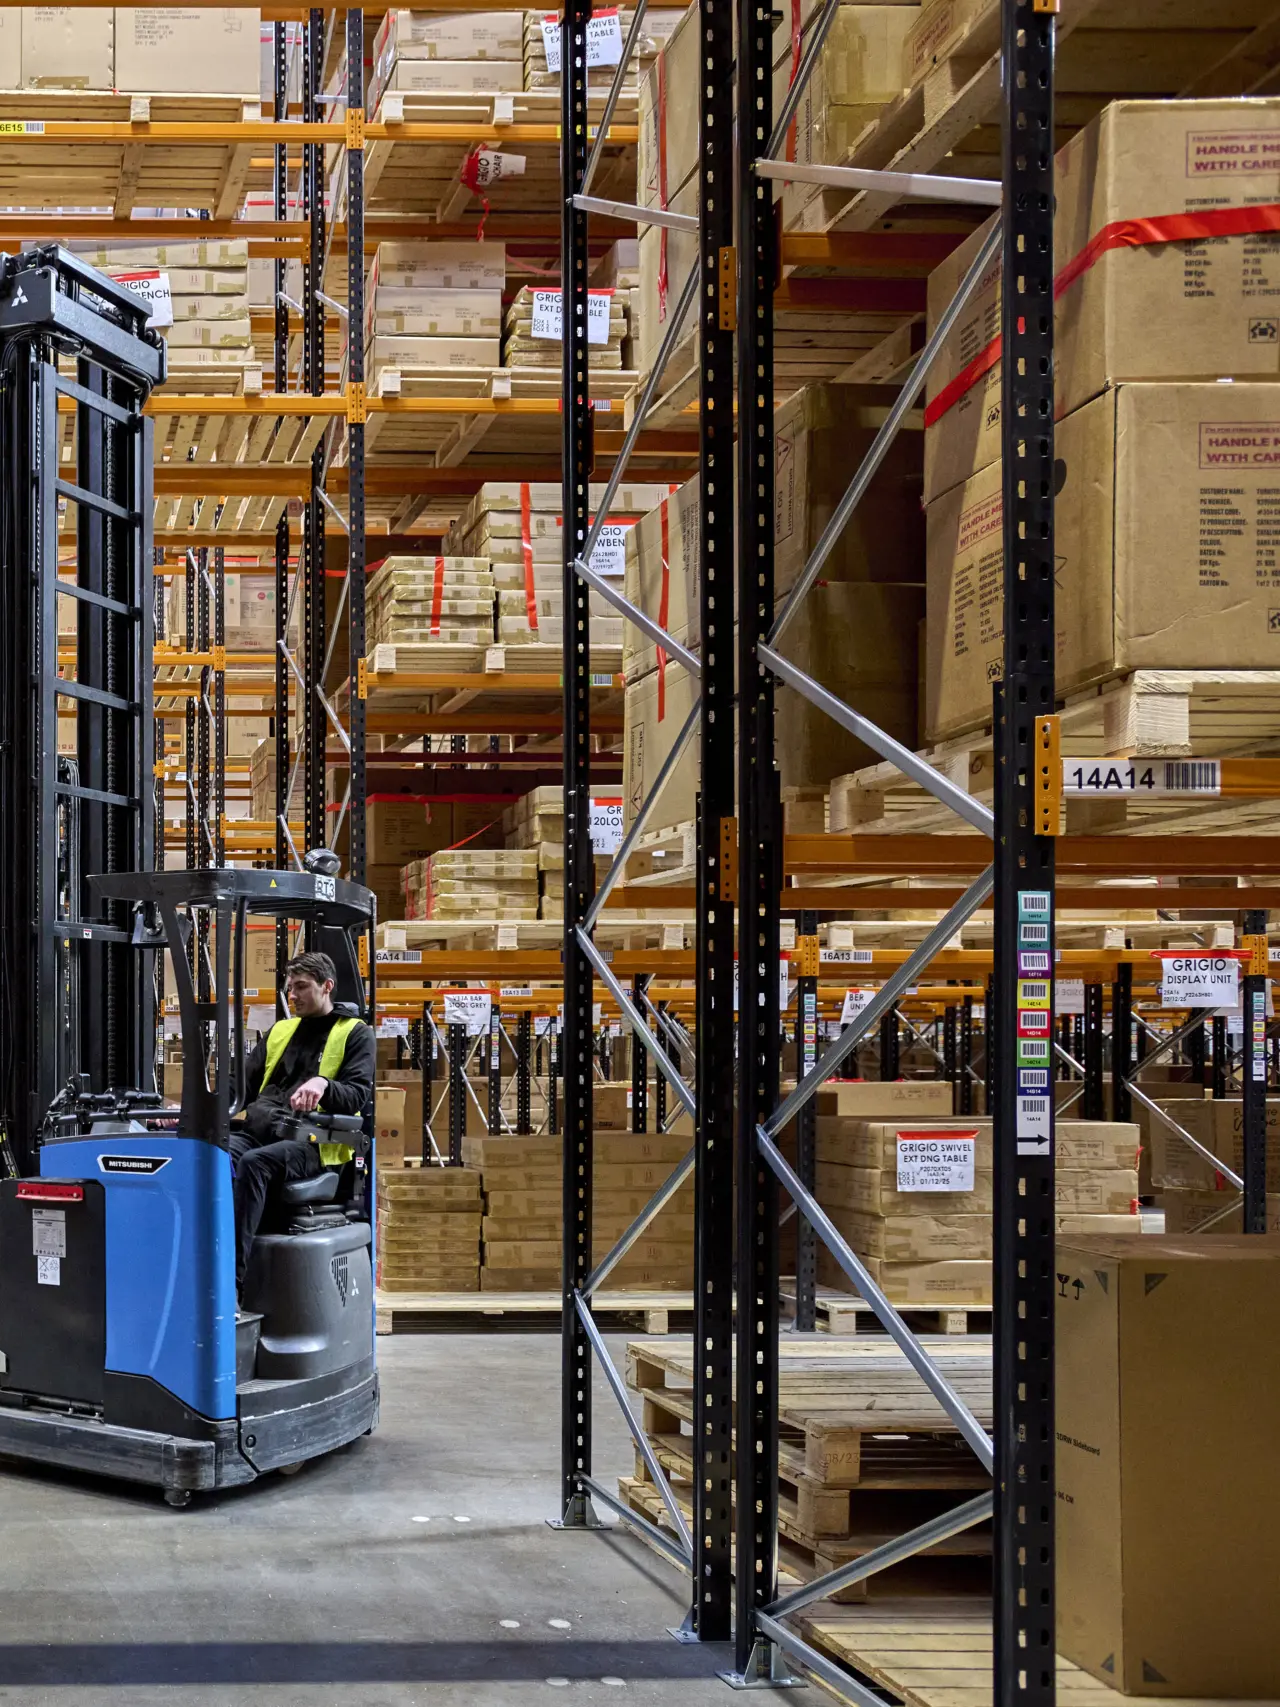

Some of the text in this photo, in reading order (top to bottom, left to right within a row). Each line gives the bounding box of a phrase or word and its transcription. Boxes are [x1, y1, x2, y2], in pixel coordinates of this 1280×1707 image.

[550, 29, 614, 44] EX TABLE
[1196, 144, 1258, 155] HANDLE
[1194, 160, 1237, 171] WITH
[121, 281, 150, 290] IGIO
[536, 292, 608, 308] GRIG IVEL
[540, 304, 554, 312] EXT
[1209, 438, 1270, 447] HANDLE
[1207, 453, 1248, 463] WITH
[960, 510, 991, 534] HANDLE
[600, 527, 622, 536] GIO
[596, 538, 624, 547] WBEN
[960, 530, 979, 548] WITH
[1072, 768, 1155, 790] 14A14
[376, 952, 400, 961] 6A14
[824, 952, 850, 960] 16A13
[1172, 959, 1226, 972] GRIGIO
[1168, 974, 1232, 984] DISPLAY UNIT
[900, 1143, 972, 1152] GRIGIO SWIVEL
[109, 1160, 152, 1168] MITSUBISHI
[40, 1272, 48, 1280] Pb
[825, 1453, 860, 1464] 08/23
